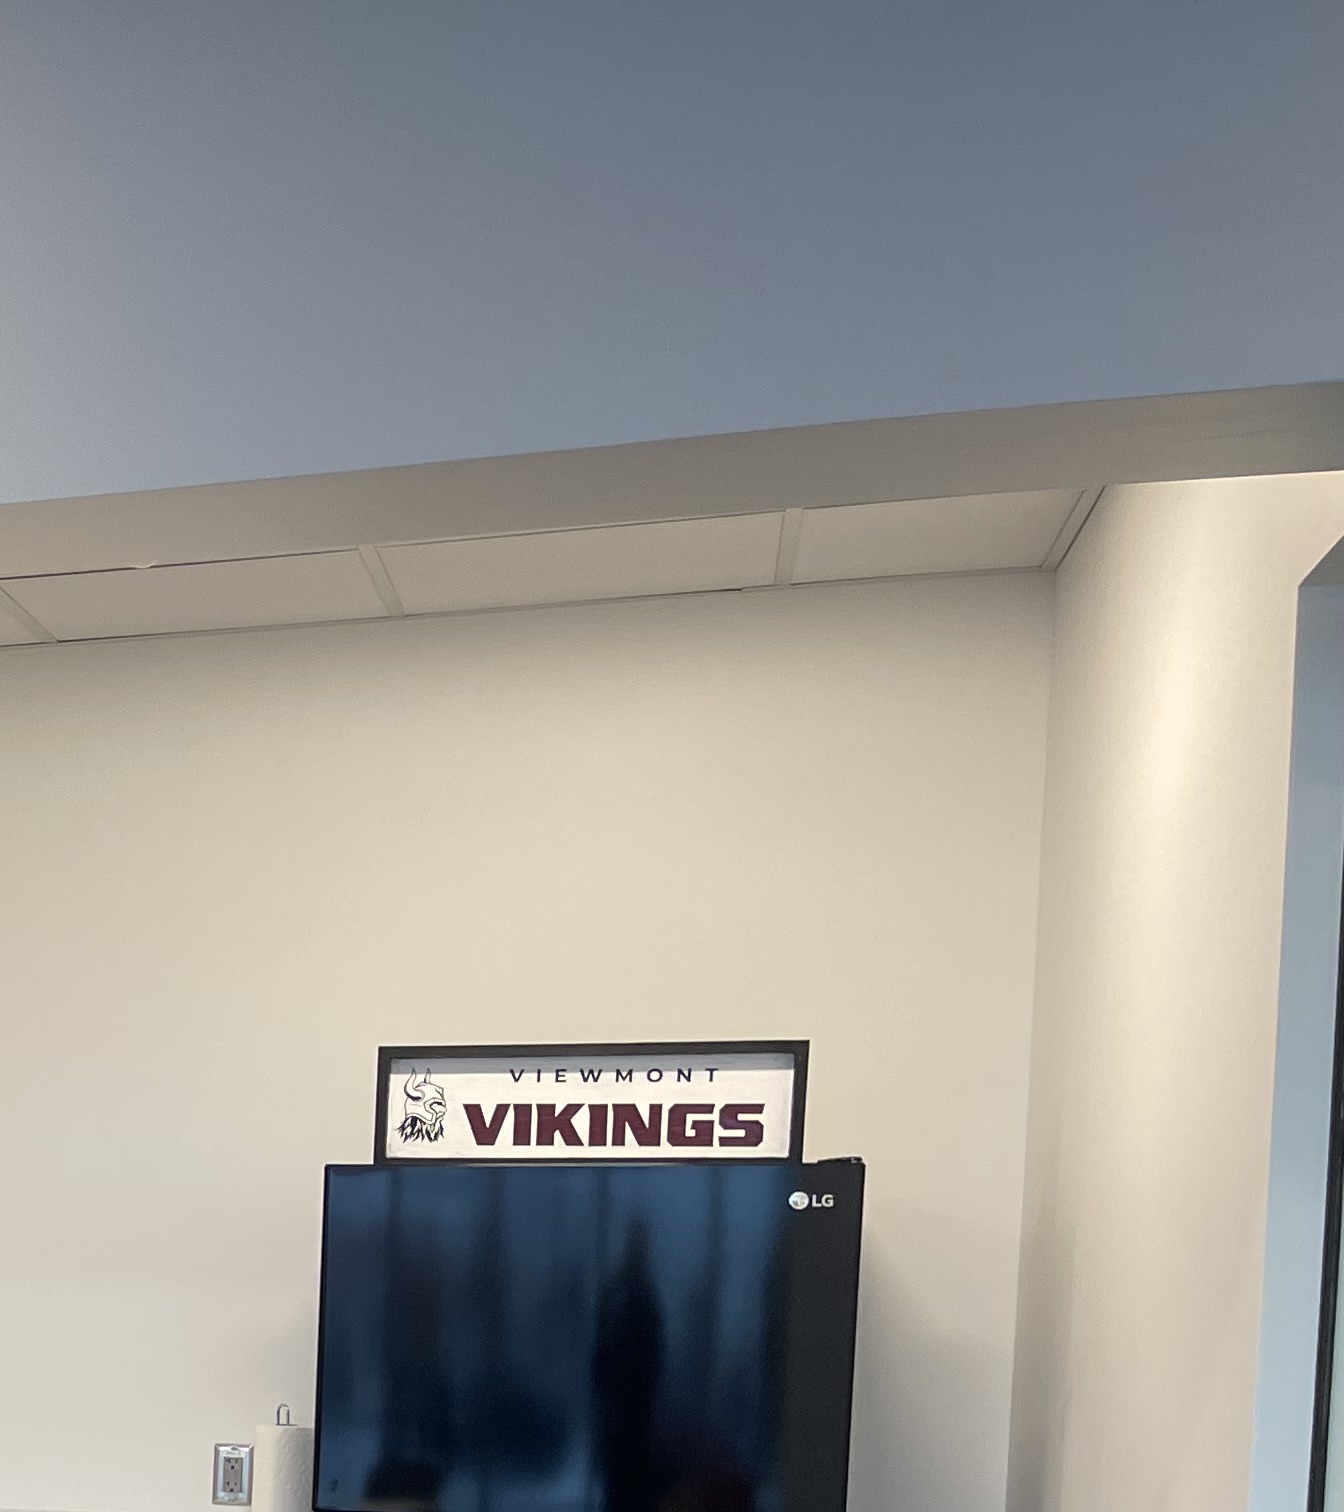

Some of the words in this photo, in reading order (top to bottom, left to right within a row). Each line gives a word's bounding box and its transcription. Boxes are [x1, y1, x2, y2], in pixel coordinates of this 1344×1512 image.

[509, 1067, 720, 1083] VIEWMONT
[462, 1103, 766, 1147] VIKINGS
[811, 1194, 834, 1207] LG
